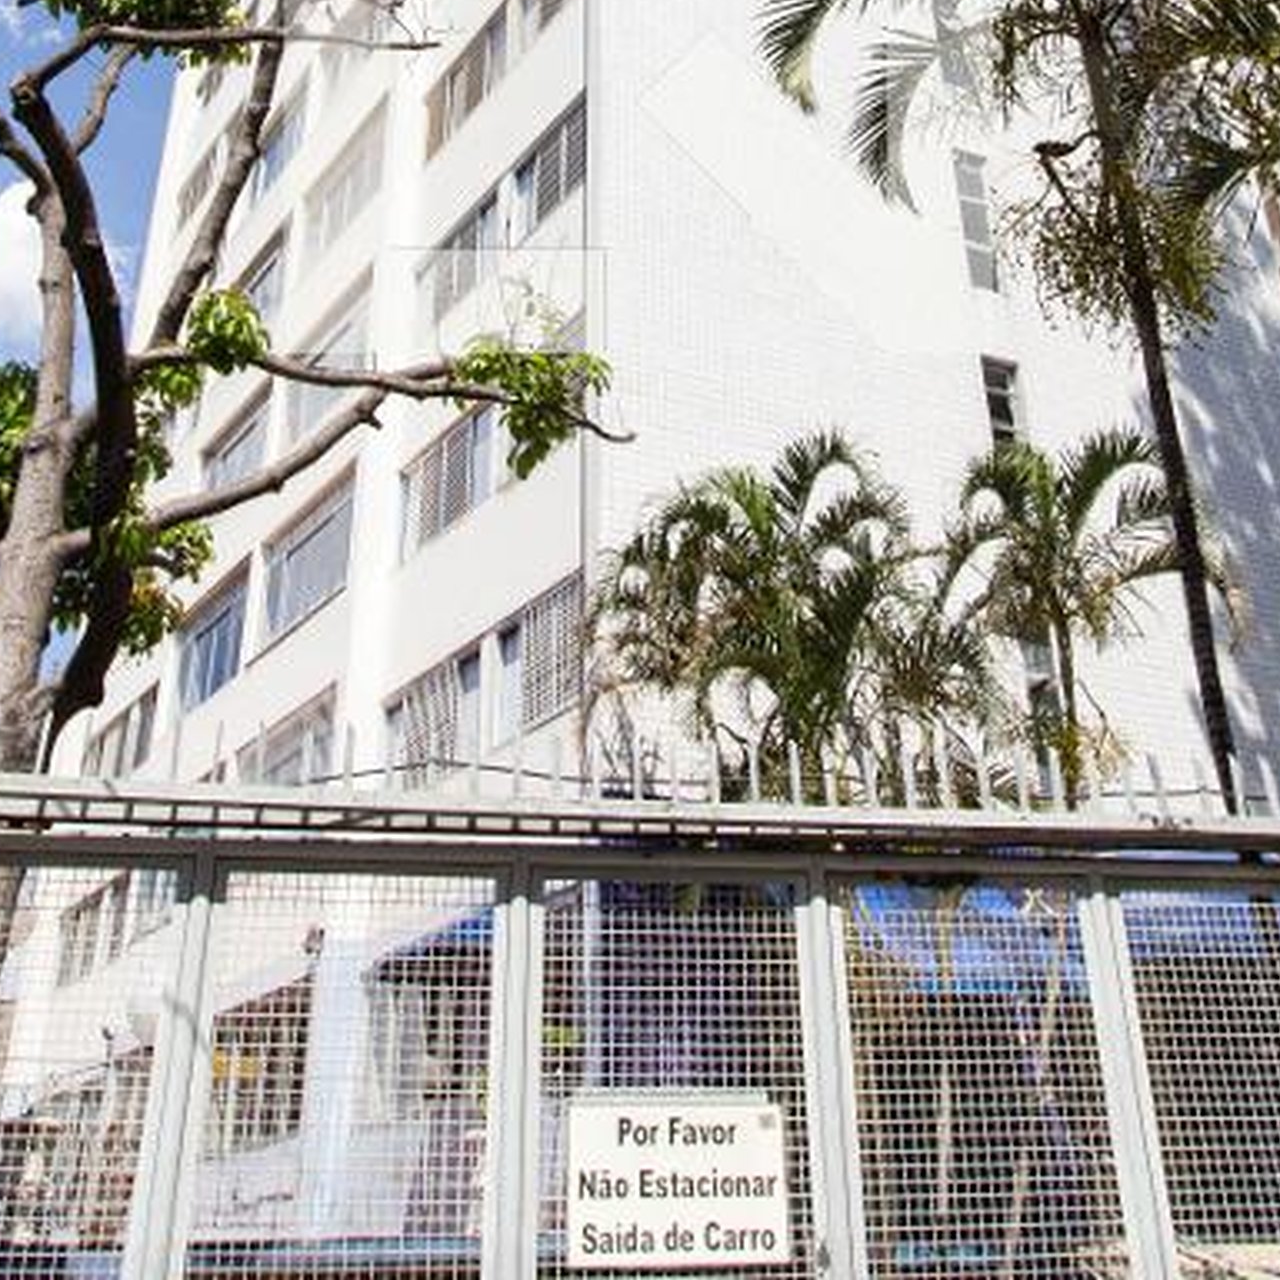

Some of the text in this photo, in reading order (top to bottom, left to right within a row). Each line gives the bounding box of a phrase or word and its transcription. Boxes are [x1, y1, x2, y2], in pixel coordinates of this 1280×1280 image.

[617, 1116, 737, 1146] Por Favor
[578, 1168, 778, 1200] Não Estacionar
[663, 1220, 695, 1252] de
[704, 1221, 776, 1252] Carro
